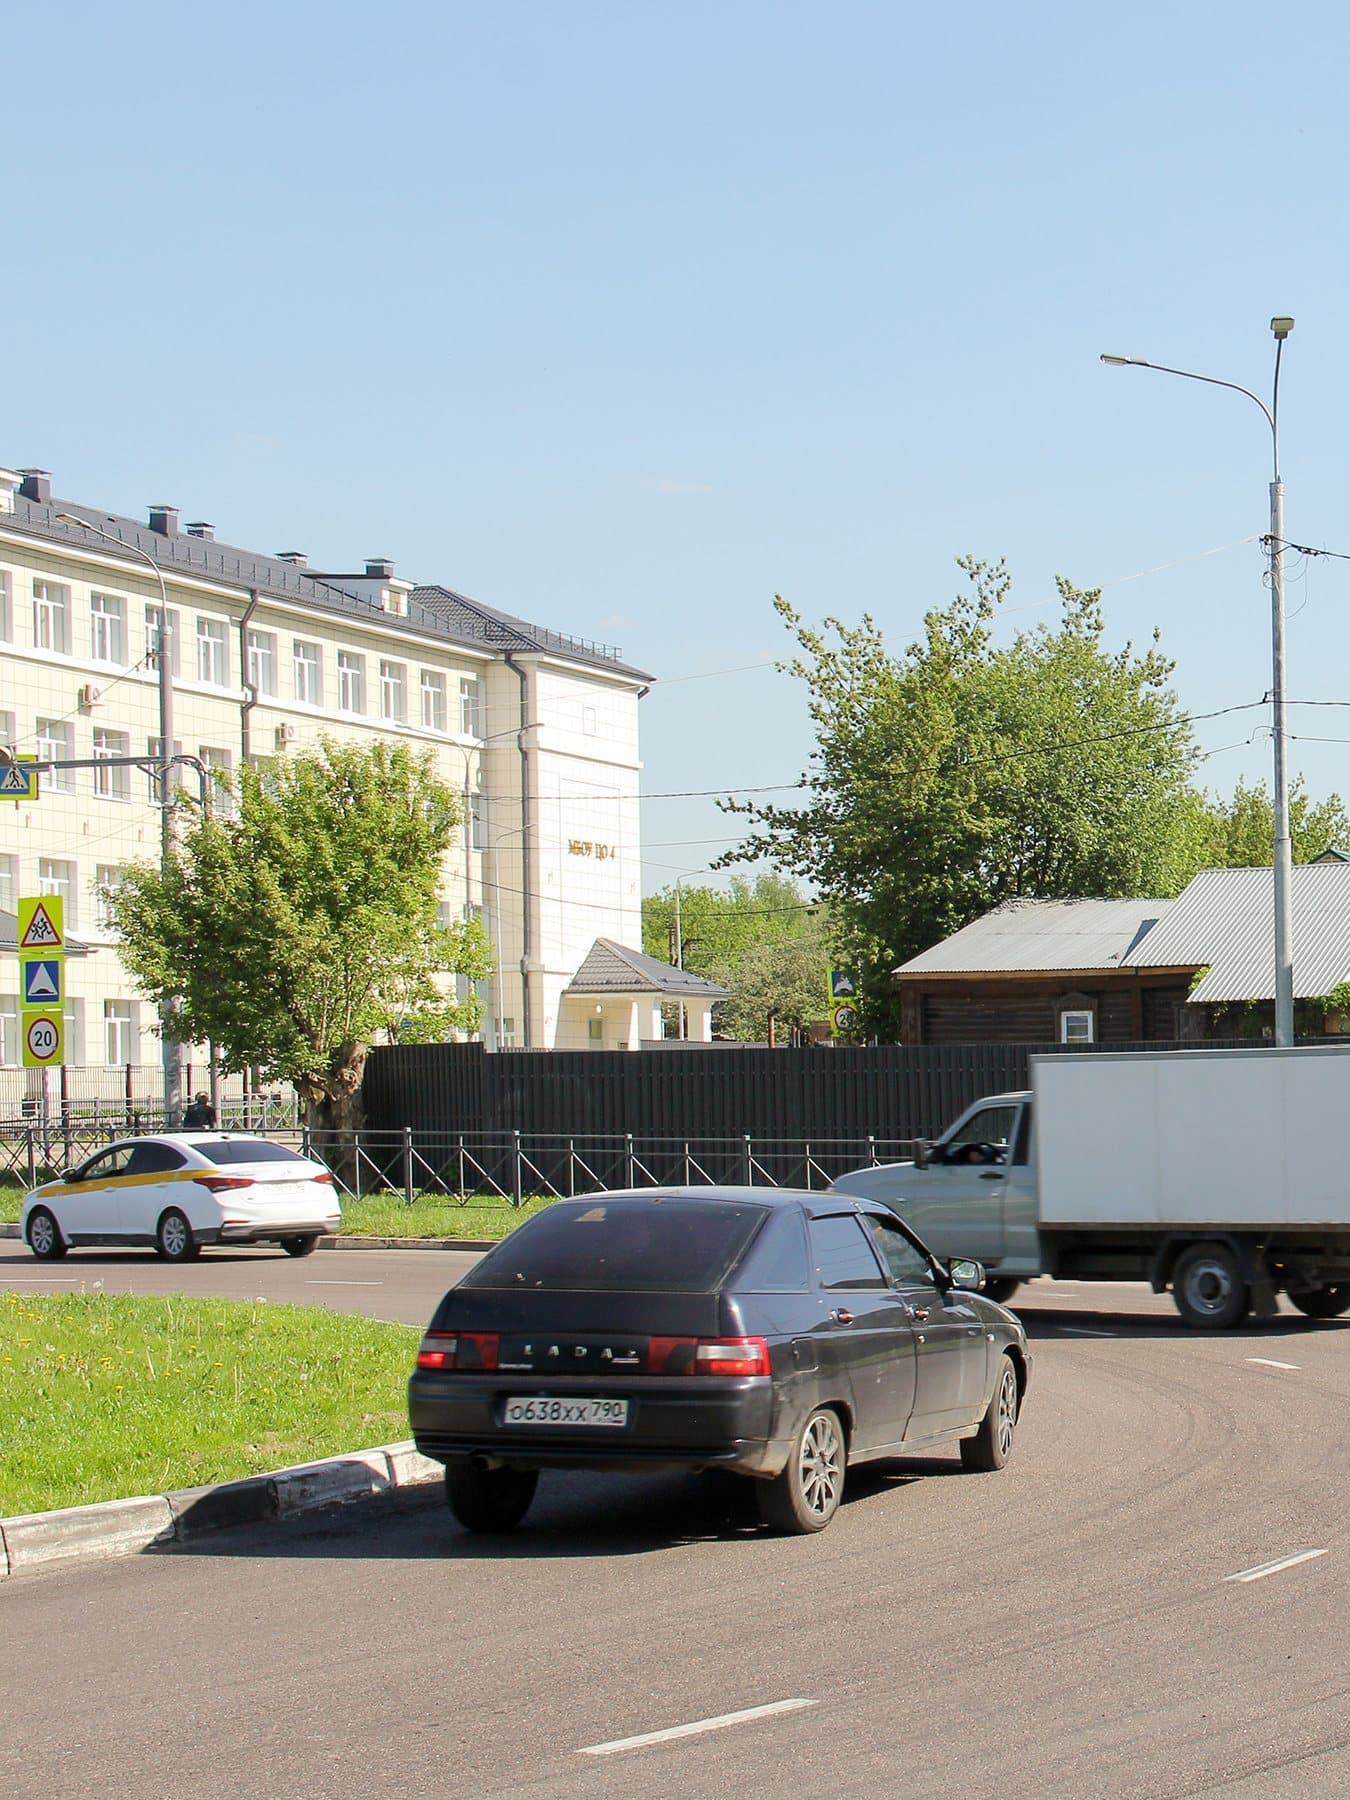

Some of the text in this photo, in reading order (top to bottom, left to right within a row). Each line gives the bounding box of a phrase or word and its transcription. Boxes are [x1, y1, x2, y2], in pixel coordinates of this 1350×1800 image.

[34, 1030, 52, 1047] 20
[524, 1344, 613, 1358] LADA
[591, 1401, 622, 1418] 790
